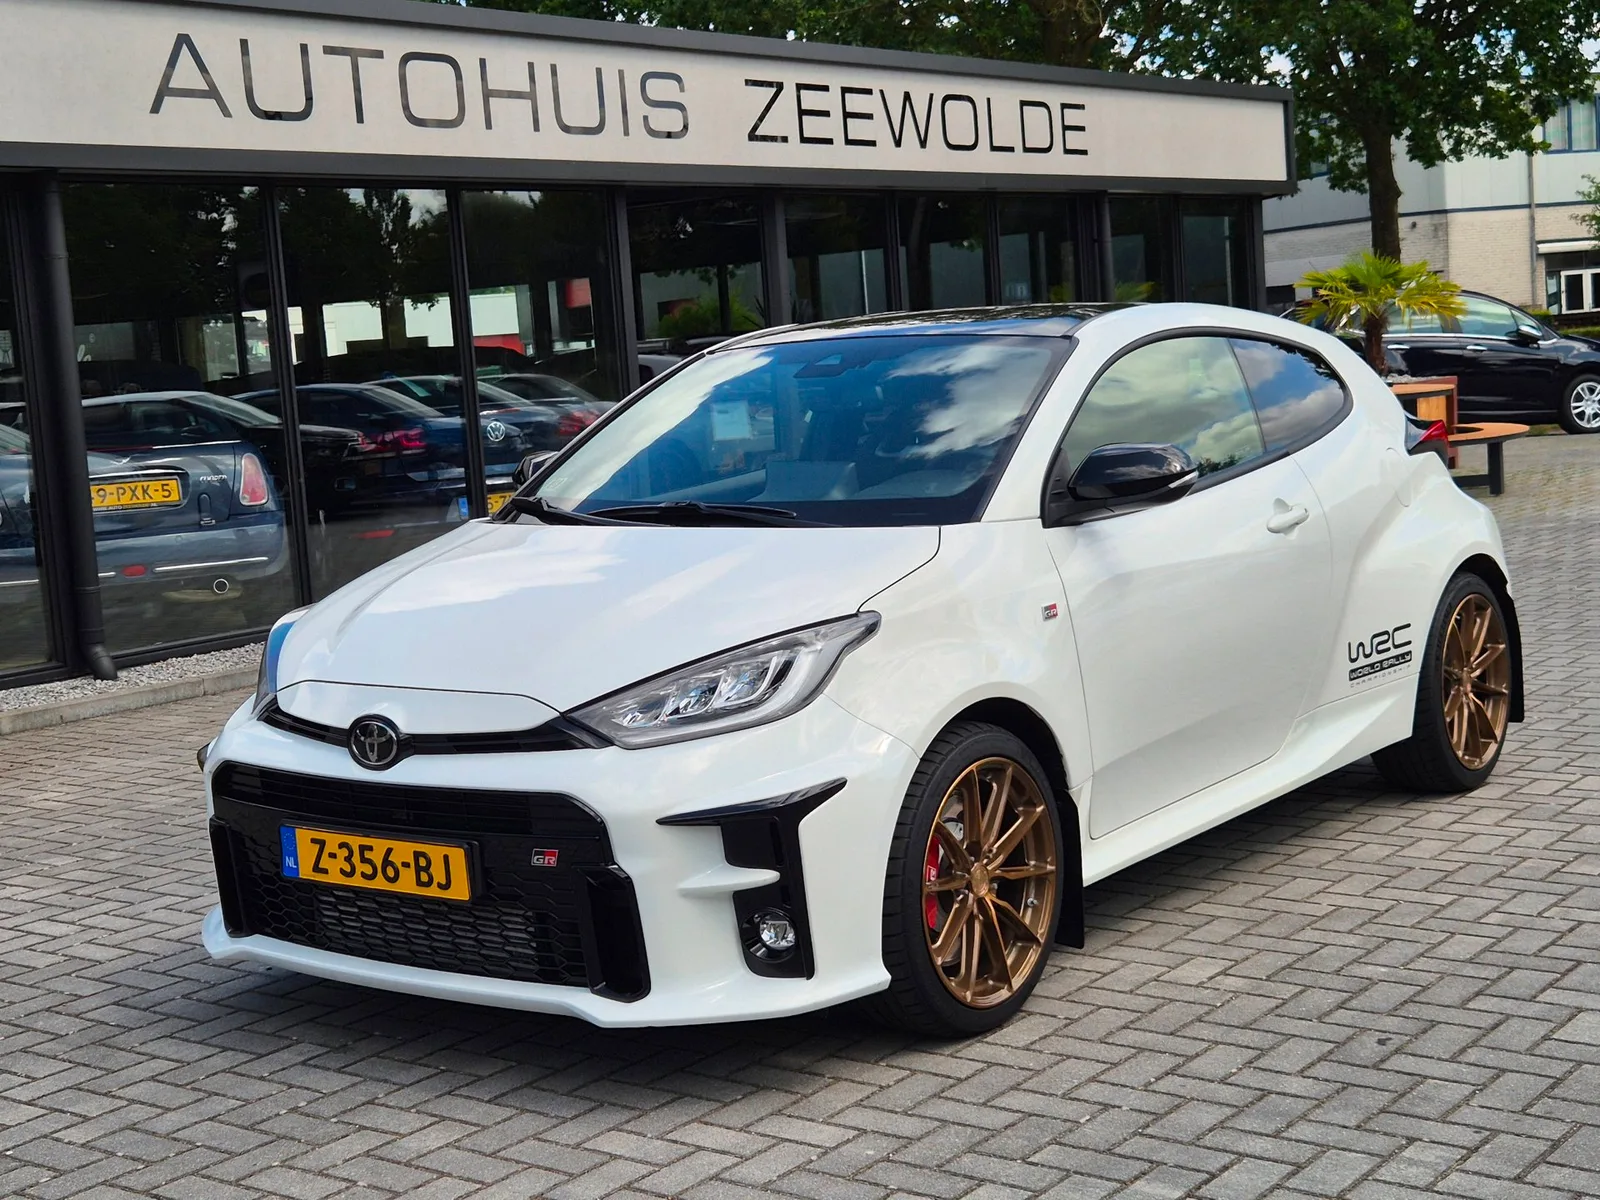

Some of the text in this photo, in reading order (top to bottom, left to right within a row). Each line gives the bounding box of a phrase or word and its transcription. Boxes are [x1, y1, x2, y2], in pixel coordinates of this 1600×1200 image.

[149, 33, 1089, 156] AUTOHUIS ZEEWOLDE
[91, 483, 173, 503] 9-PXK-5
[1348, 623, 1412, 664] WRC
[1350, 653, 1410, 679] WORLD RALLY
[285, 855, 298, 869] NL
[310, 837, 452, 891] Z-356-BJ
[533, 855, 556, 865] GR
